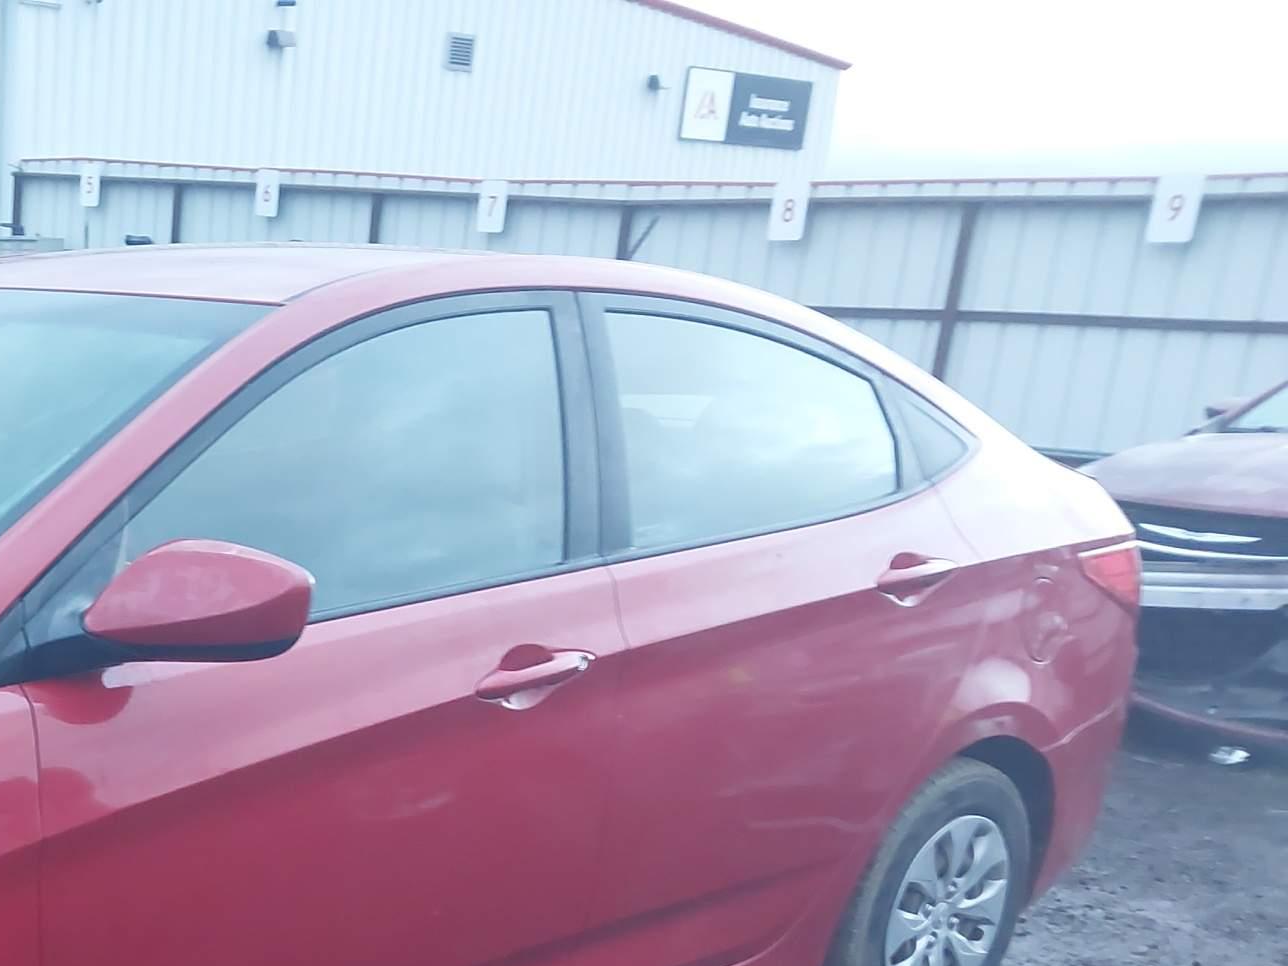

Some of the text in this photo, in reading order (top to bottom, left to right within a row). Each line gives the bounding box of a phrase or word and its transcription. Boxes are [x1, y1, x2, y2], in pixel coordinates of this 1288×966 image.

[85, 175, 95, 194] 5
[262, 184, 272, 202] 6
[487, 194, 497, 217] 7
[782, 198, 795, 223] 8
[1168, 193, 1186, 222] 9
